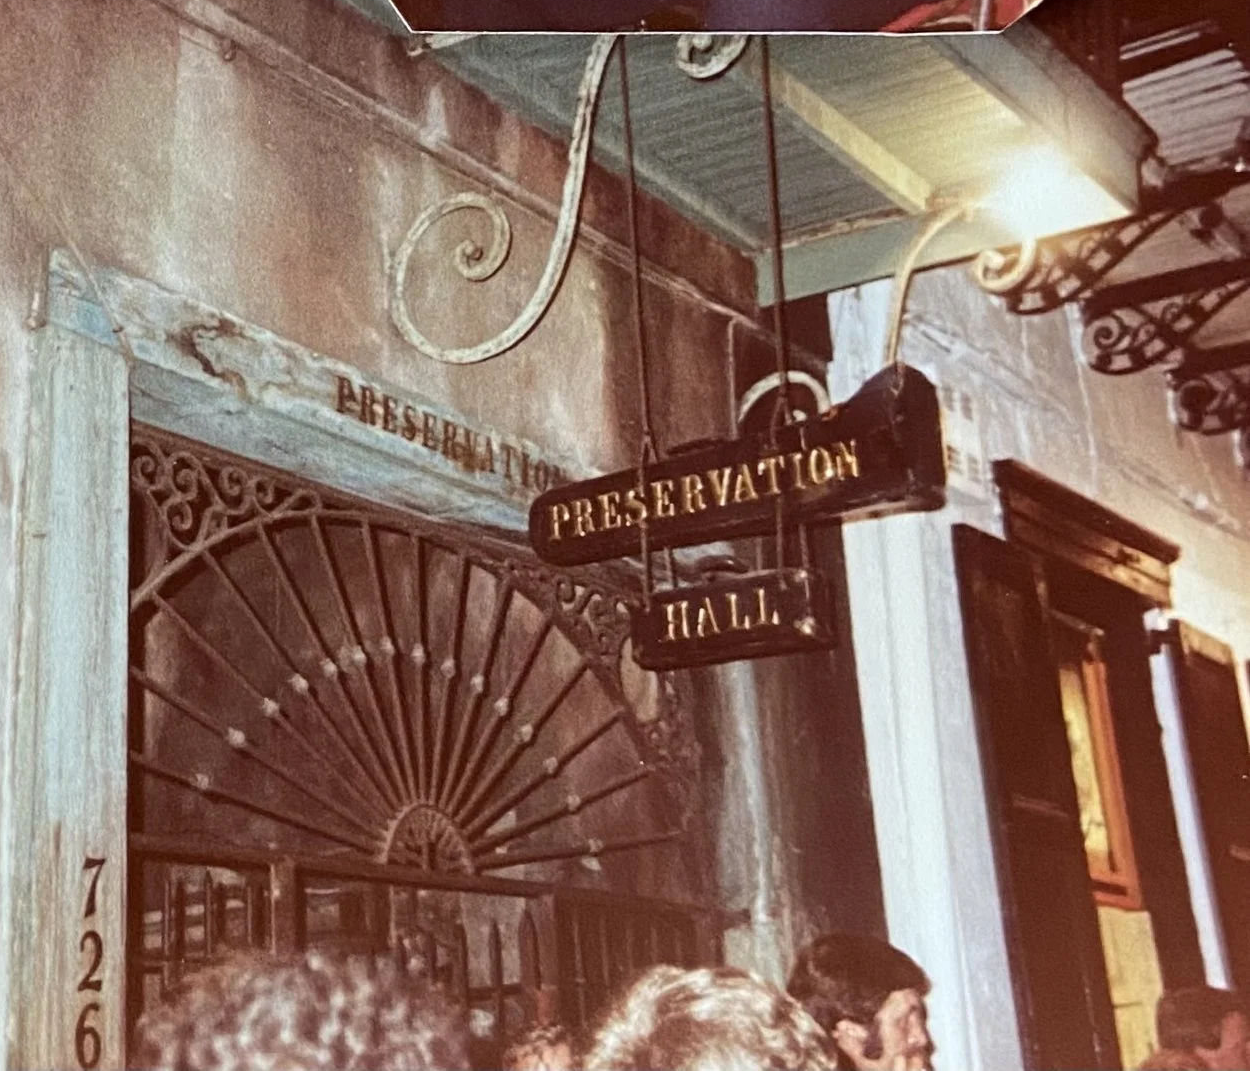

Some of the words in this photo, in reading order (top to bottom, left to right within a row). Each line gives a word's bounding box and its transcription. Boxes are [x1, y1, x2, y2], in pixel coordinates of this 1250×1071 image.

[336, 375, 570, 493] PRESERVATION
[549, 438, 860, 541] PRESERVATION
[661, 588, 781, 642] HALL
[75, 856, 107, 1071] 726
